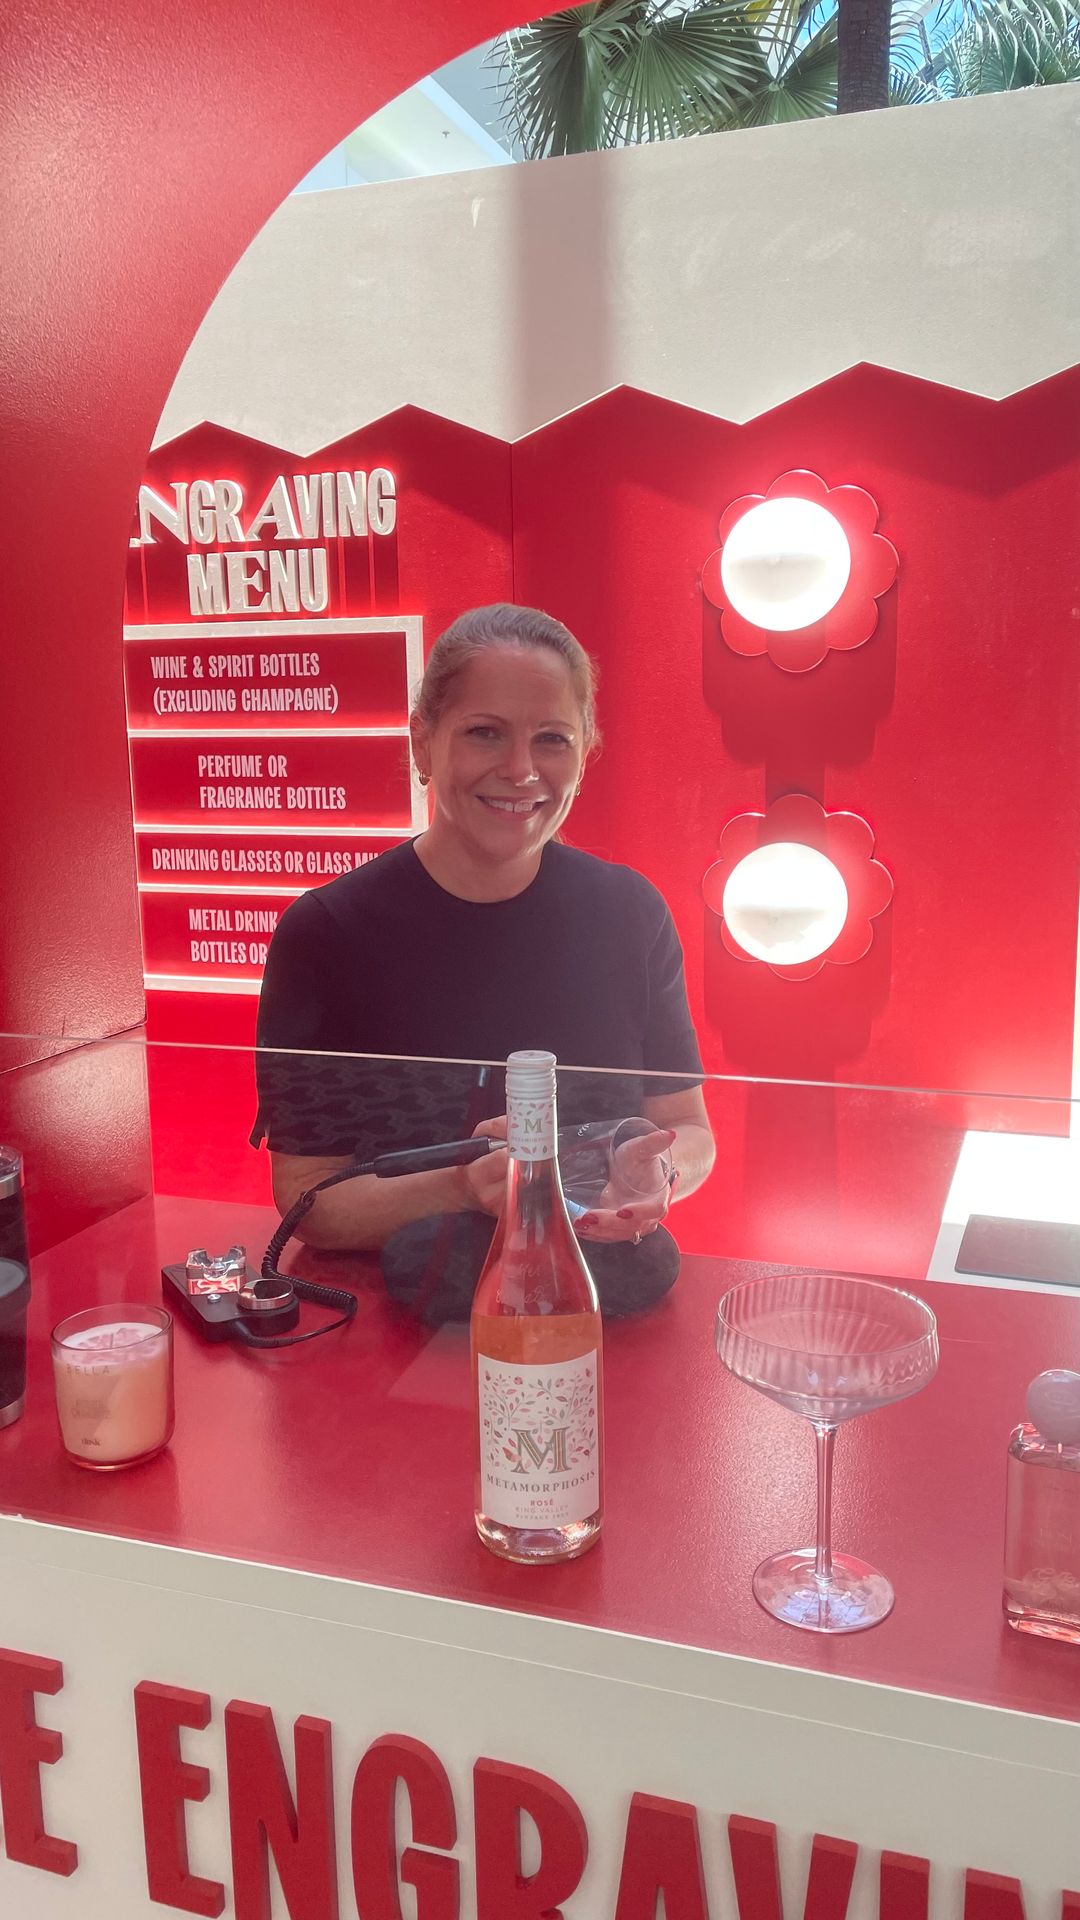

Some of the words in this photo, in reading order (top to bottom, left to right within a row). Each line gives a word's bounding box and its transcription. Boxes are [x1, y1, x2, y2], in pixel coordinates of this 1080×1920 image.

[129, 468, 396, 547] NGRAVING
[187, 548, 328, 615] MENU
[150, 656, 188, 679] WINE
[192, 655, 205, 678] &
[208, 654, 255, 678] SPIRIT
[260, 652, 320, 677] BOTTLES
[153, 686, 237, 715] (EXCLUDING
[241, 684, 339, 714] CHAMPAGNE)
[198, 755, 263, 778] PERFUME
[267, 755, 287, 778] OR
[199, 786, 281, 810] FRAGRANCE
[287, 786, 346, 810] BOTTLES
[152, 848, 219, 872] DRINKING
[221, 849, 282, 873] GLASSES
[284, 851, 304, 874] OR
[306, 851, 352, 874] GLASS
[189, 909, 233, 932] METAL
[190, 940, 247, 963] BOTTLES
[249, 942, 268, 965] OR
[523, 1119, 543, 1134] M
[511, 1426, 572, 1474] M
[486, 1470, 596, 1493] METAMORPHOSIS
[134, 1680, 1080, 1920] ENGRA
